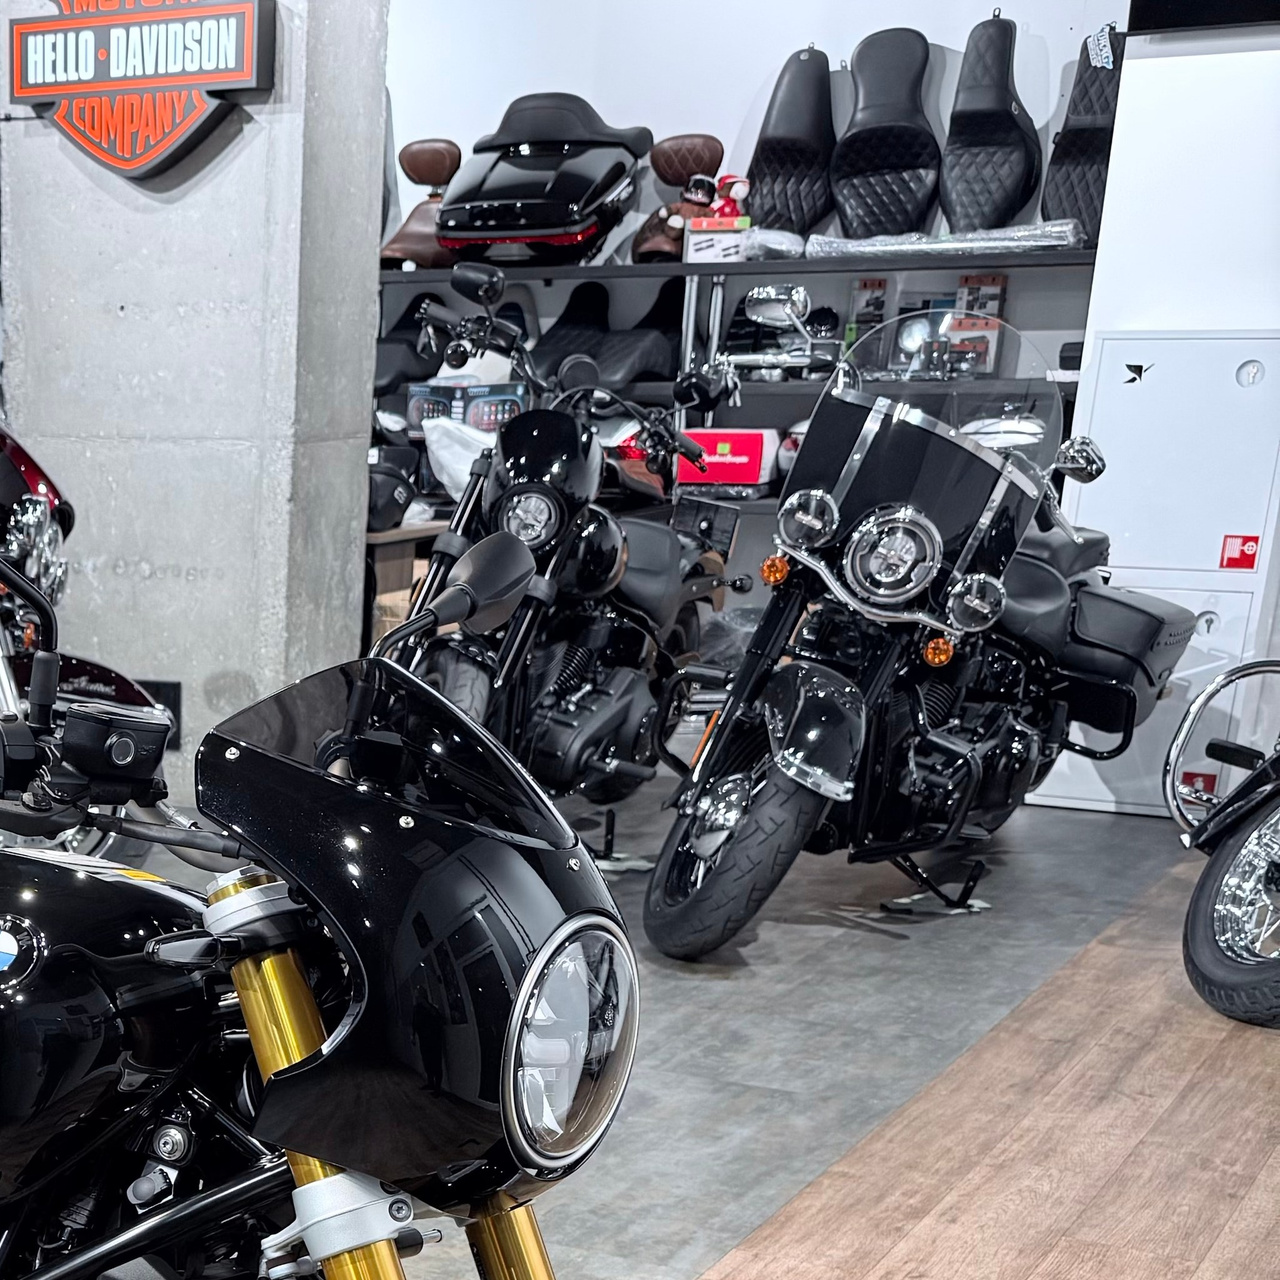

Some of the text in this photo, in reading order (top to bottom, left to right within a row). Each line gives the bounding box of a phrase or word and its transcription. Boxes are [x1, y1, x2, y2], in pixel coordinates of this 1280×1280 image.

[27, 17, 237, 84] HELLO DAVIDSON
[73, 90, 188, 157] COMPANY
